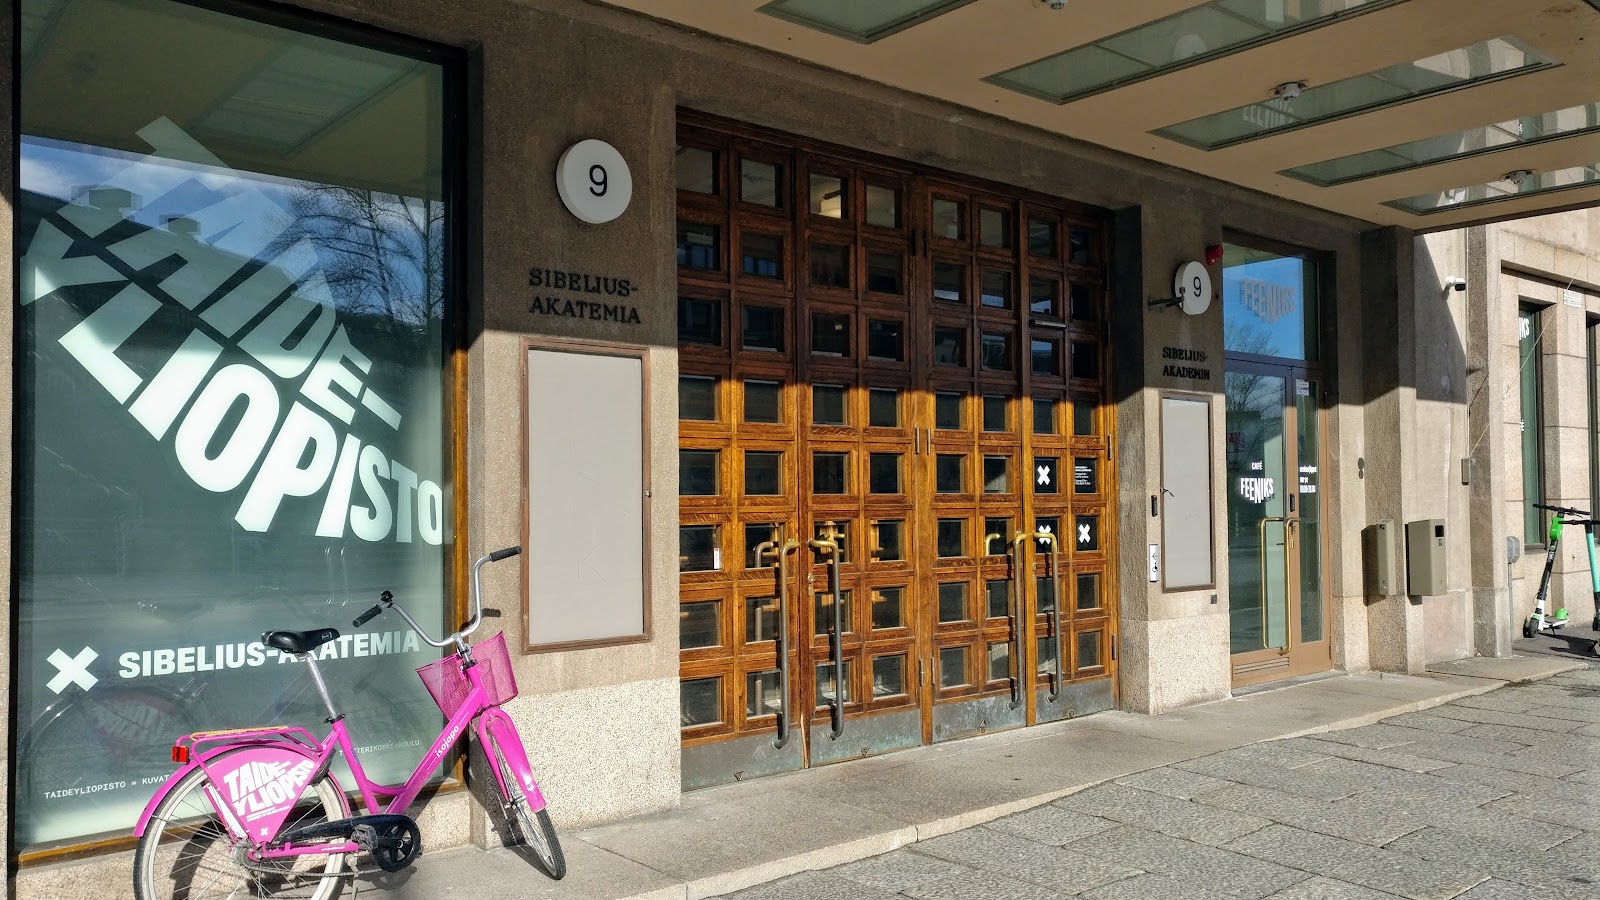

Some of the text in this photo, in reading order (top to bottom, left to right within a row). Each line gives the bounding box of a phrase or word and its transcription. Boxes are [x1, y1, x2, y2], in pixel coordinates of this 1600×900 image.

[589, 164, 608, 197] 9
[528, 267, 639, 298] SIBELIUS-
[1193, 276, 1202, 298] 9
[528, 296, 642, 325] AKATEMIA
[1242, 278, 1297, 324] FEENIKS
[20, 216, 443, 546] YLIOPISTO
[1240, 477, 1274, 504] FEENIKS
[435, 725, 460, 758] isojopo
[44, 781, 126, 800] TAIDEYLIOPISTO
[223, 760, 291, 803] TAIDE-
[232, 760, 315, 817] YLIOPISTO
